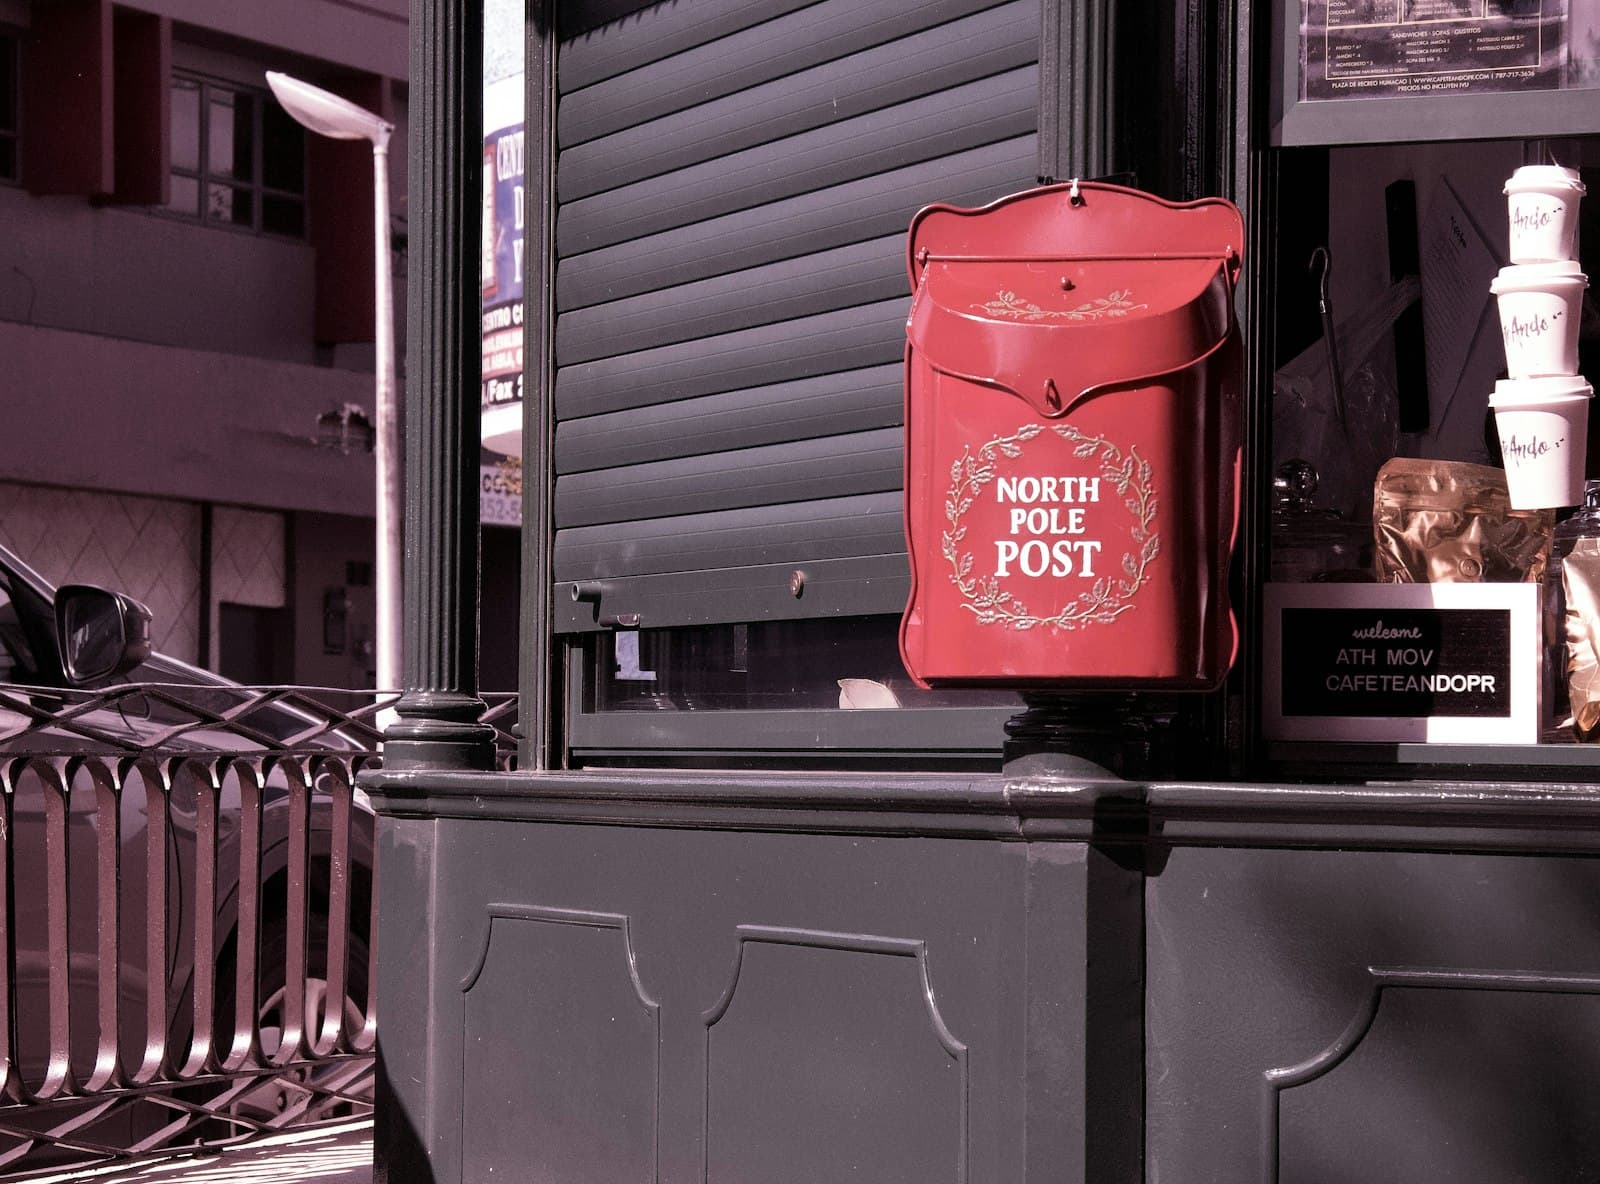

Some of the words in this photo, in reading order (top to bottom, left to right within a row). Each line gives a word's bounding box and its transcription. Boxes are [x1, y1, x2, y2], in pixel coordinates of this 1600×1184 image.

[1432, 29, 1450, 37] SOPAS
[1379, 78, 1408, 86] HUMACAO
[1413, 74, 1490, 83] WWW.CAFETEANDOPR.COM
[997, 477, 1101, 503] NORTH
[1010, 508, 1086, 535] POLE
[994, 540, 1102, 577] POST
[1352, 620, 1423, 639] welcome
[1336, 649, 1376, 665] ATH
[1386, 649, 1434, 666] MOV
[1326, 674, 1497, 693] CAFETEANDOPR
